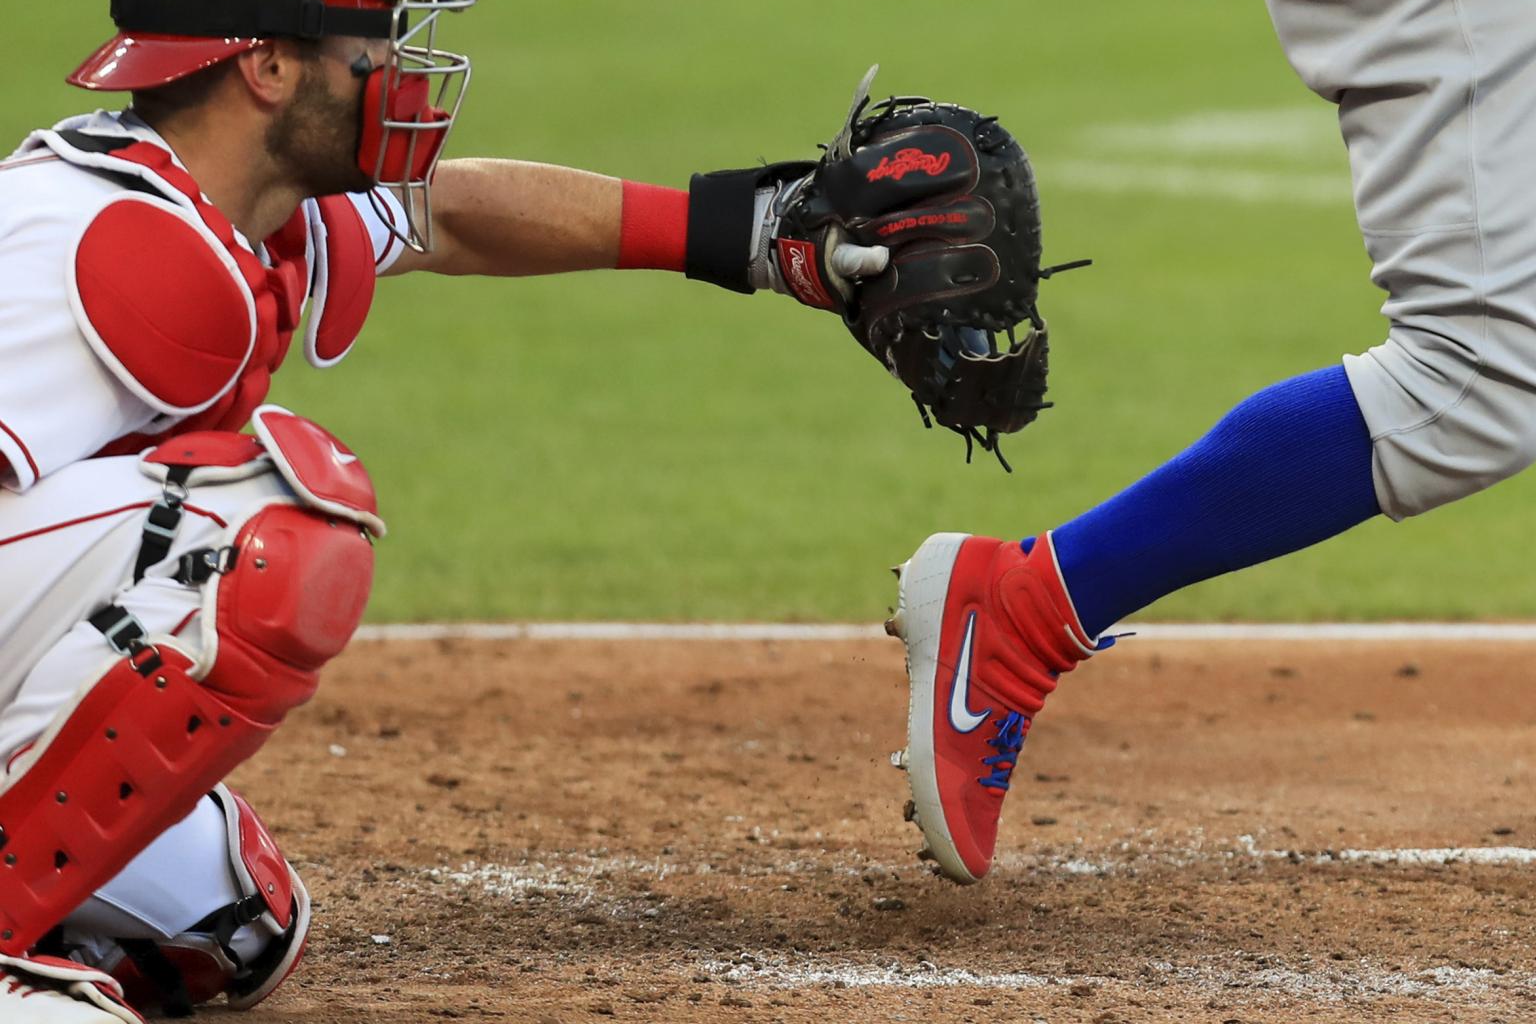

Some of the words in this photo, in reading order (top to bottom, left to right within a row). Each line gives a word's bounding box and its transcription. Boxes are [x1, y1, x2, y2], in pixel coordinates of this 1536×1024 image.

[867, 148, 951, 182] Rawlings
[888, 217, 917, 233] GLOVE
[918, 214, 945, 226] GOLD
